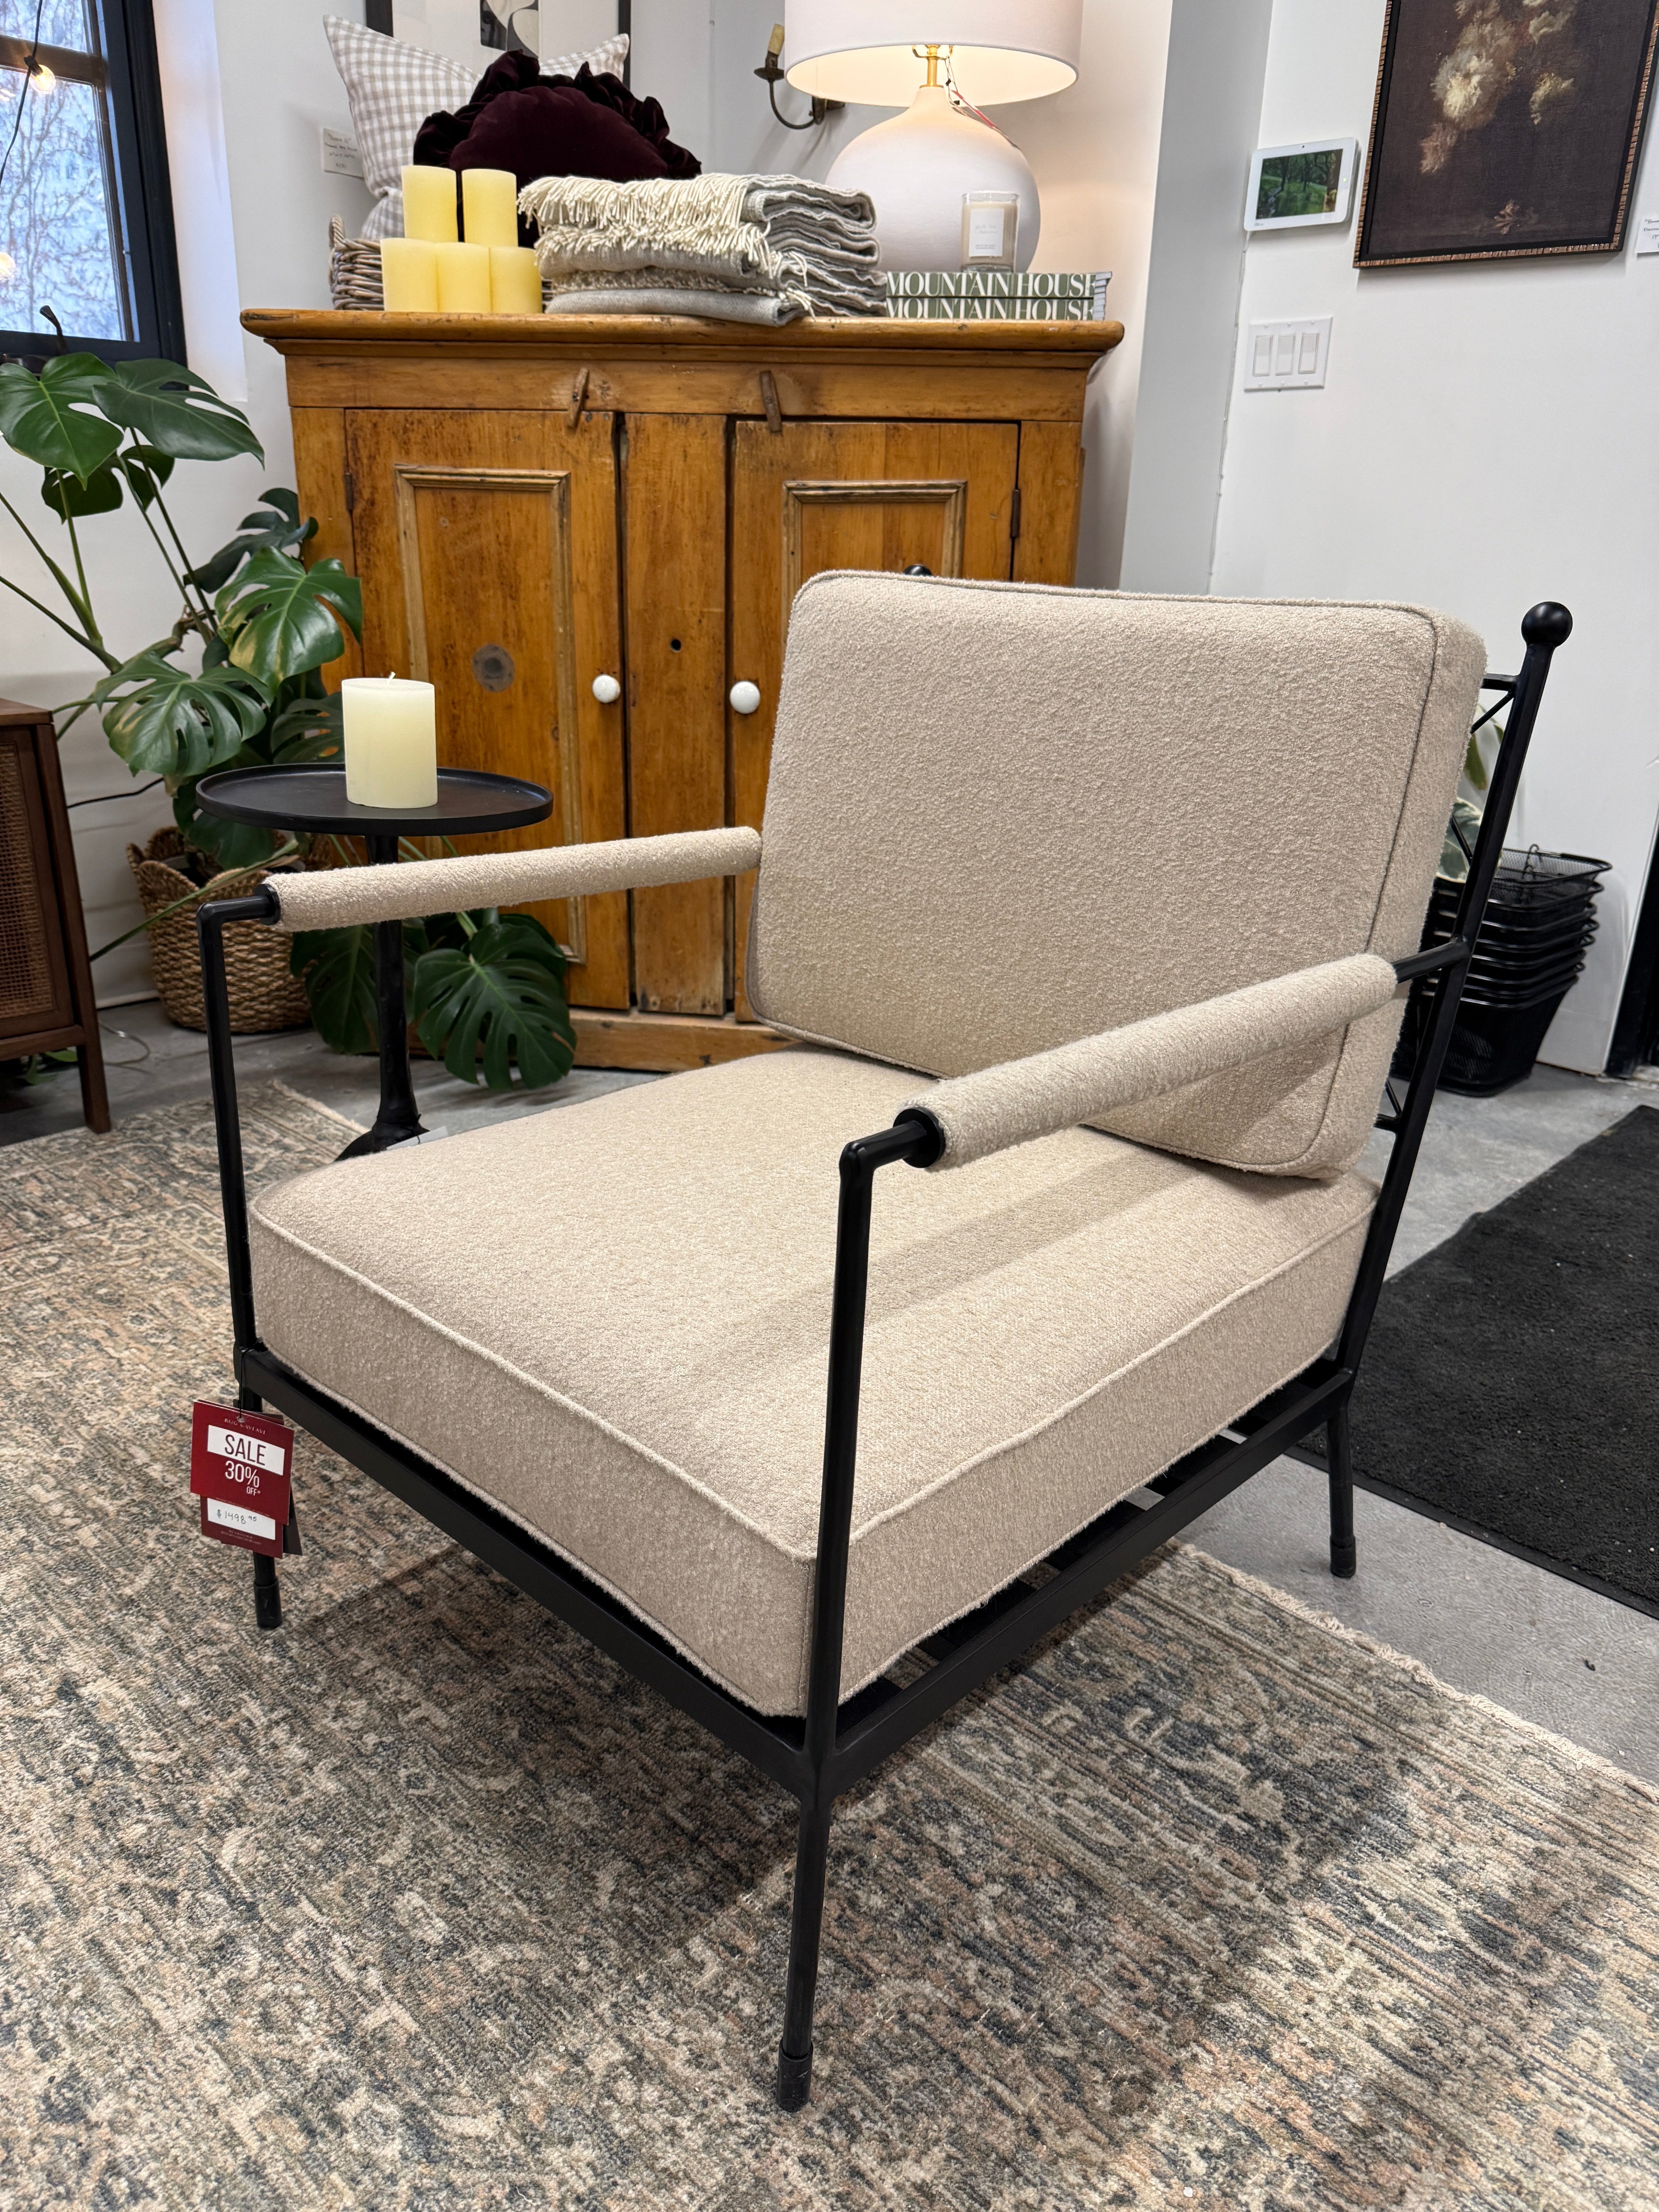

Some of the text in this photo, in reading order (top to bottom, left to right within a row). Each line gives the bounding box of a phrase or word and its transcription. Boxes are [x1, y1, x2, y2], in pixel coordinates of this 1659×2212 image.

[885, 271, 1010, 297] MOUNTAIN
[885, 297, 1008, 319] MOUNTAIN
[225, 1434, 266, 1466] SALE
[225, 1460, 259, 1488] 30%
